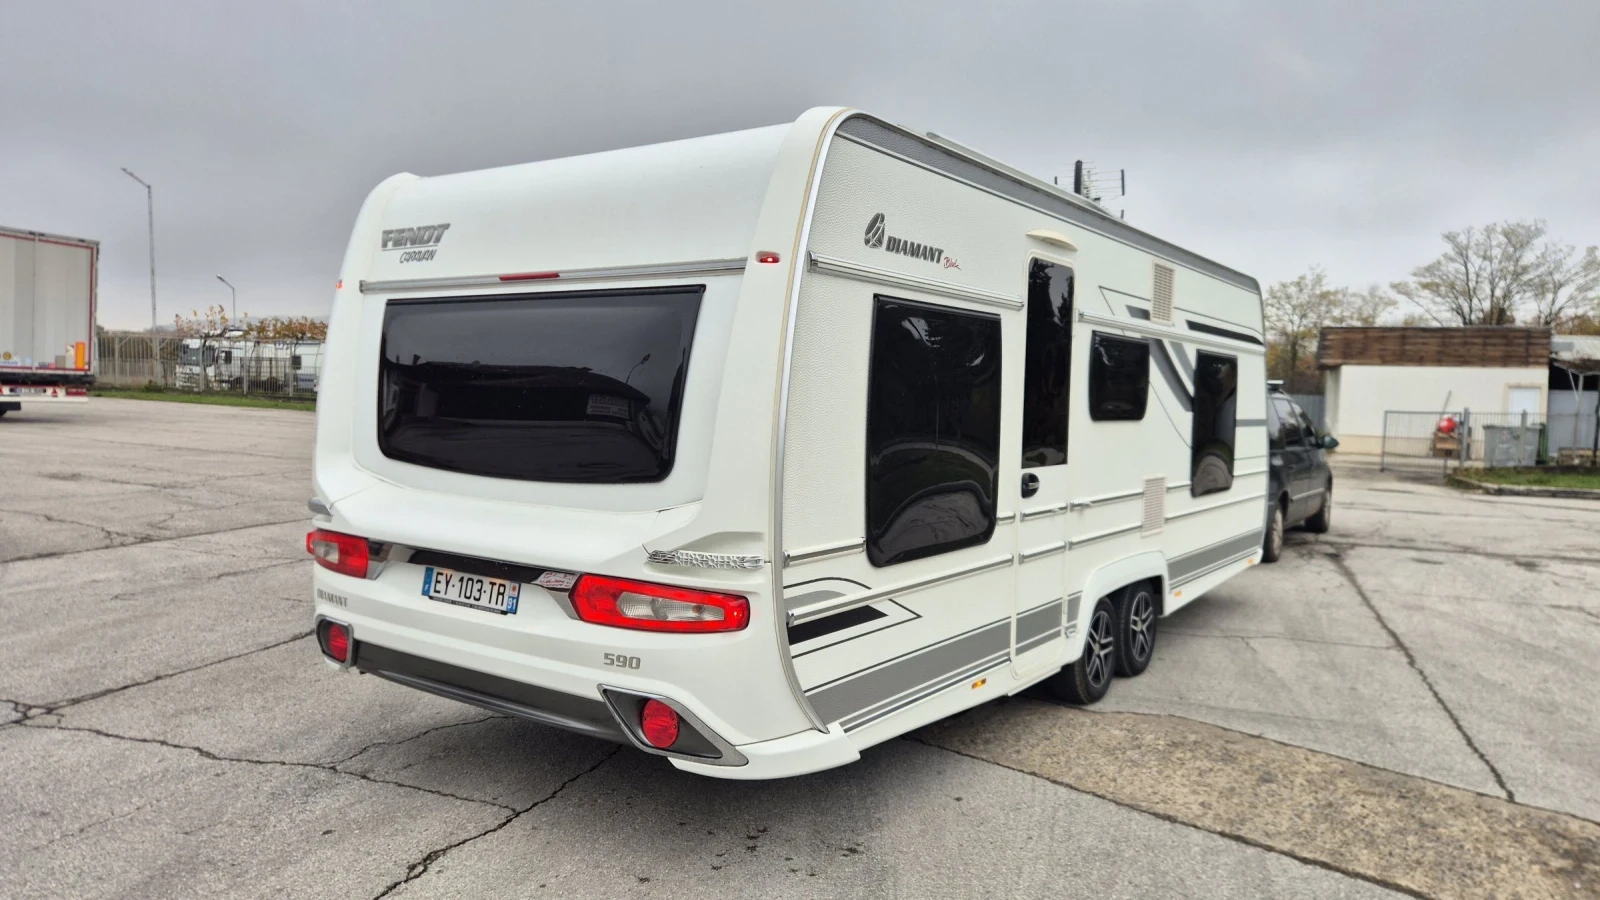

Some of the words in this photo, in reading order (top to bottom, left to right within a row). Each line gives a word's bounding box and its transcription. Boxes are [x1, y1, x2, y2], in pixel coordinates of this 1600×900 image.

[381, 223, 451, 248] FENDT
[399, 248, 437, 264] CARAVAN
[885, 235, 944, 264] DIAMANT
[312, 588, 348, 608] DIAMANT
[507, 597, 517, 610] 91
[603, 652, 641, 670] 590
